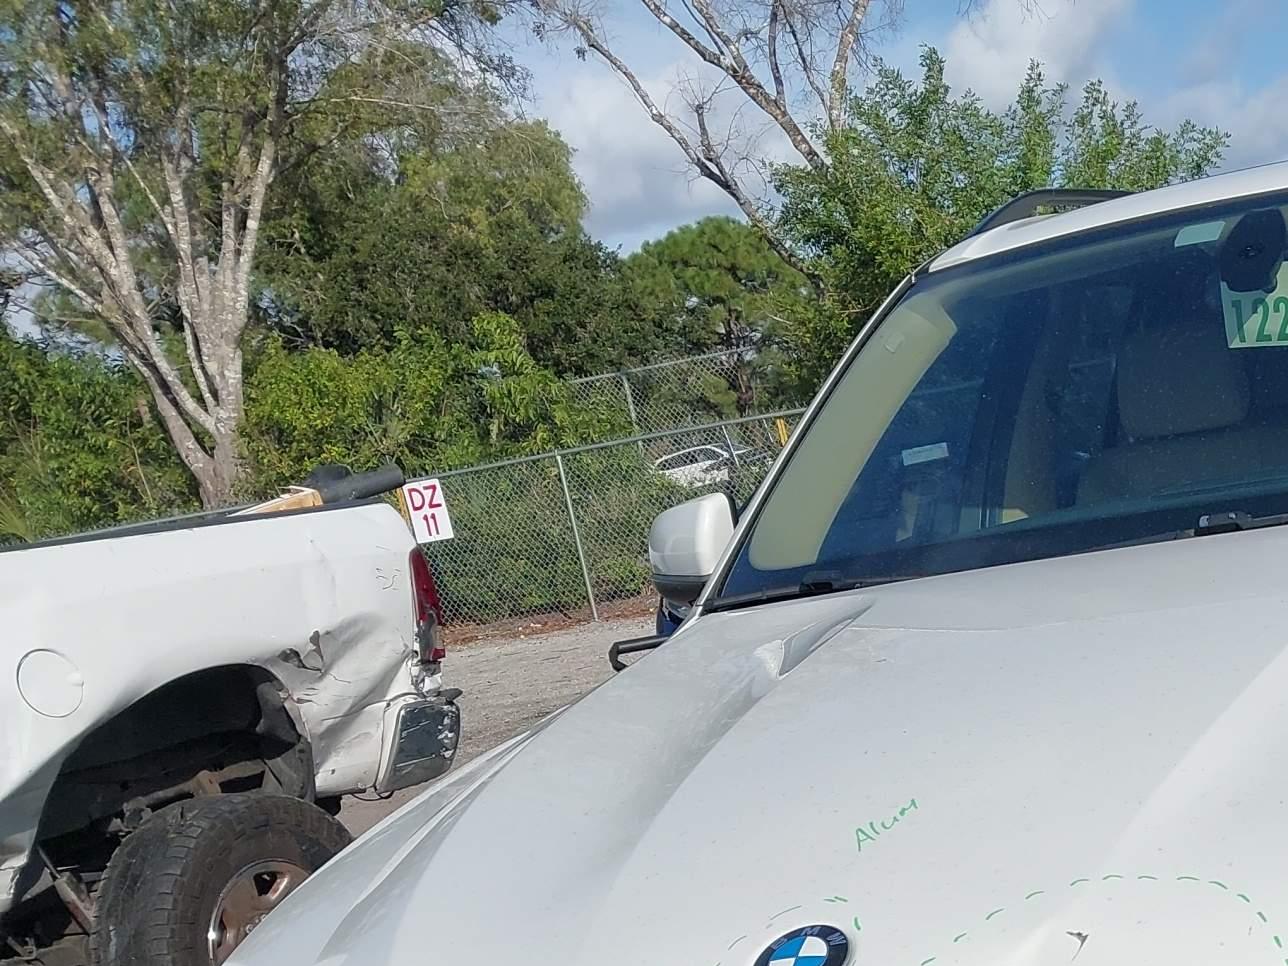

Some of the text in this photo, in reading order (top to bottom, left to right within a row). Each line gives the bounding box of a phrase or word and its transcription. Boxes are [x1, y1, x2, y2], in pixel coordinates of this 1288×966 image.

[407, 484, 443, 512] DZ
[422, 512, 440, 537] 11
[770, 926, 848, 950] BMW
